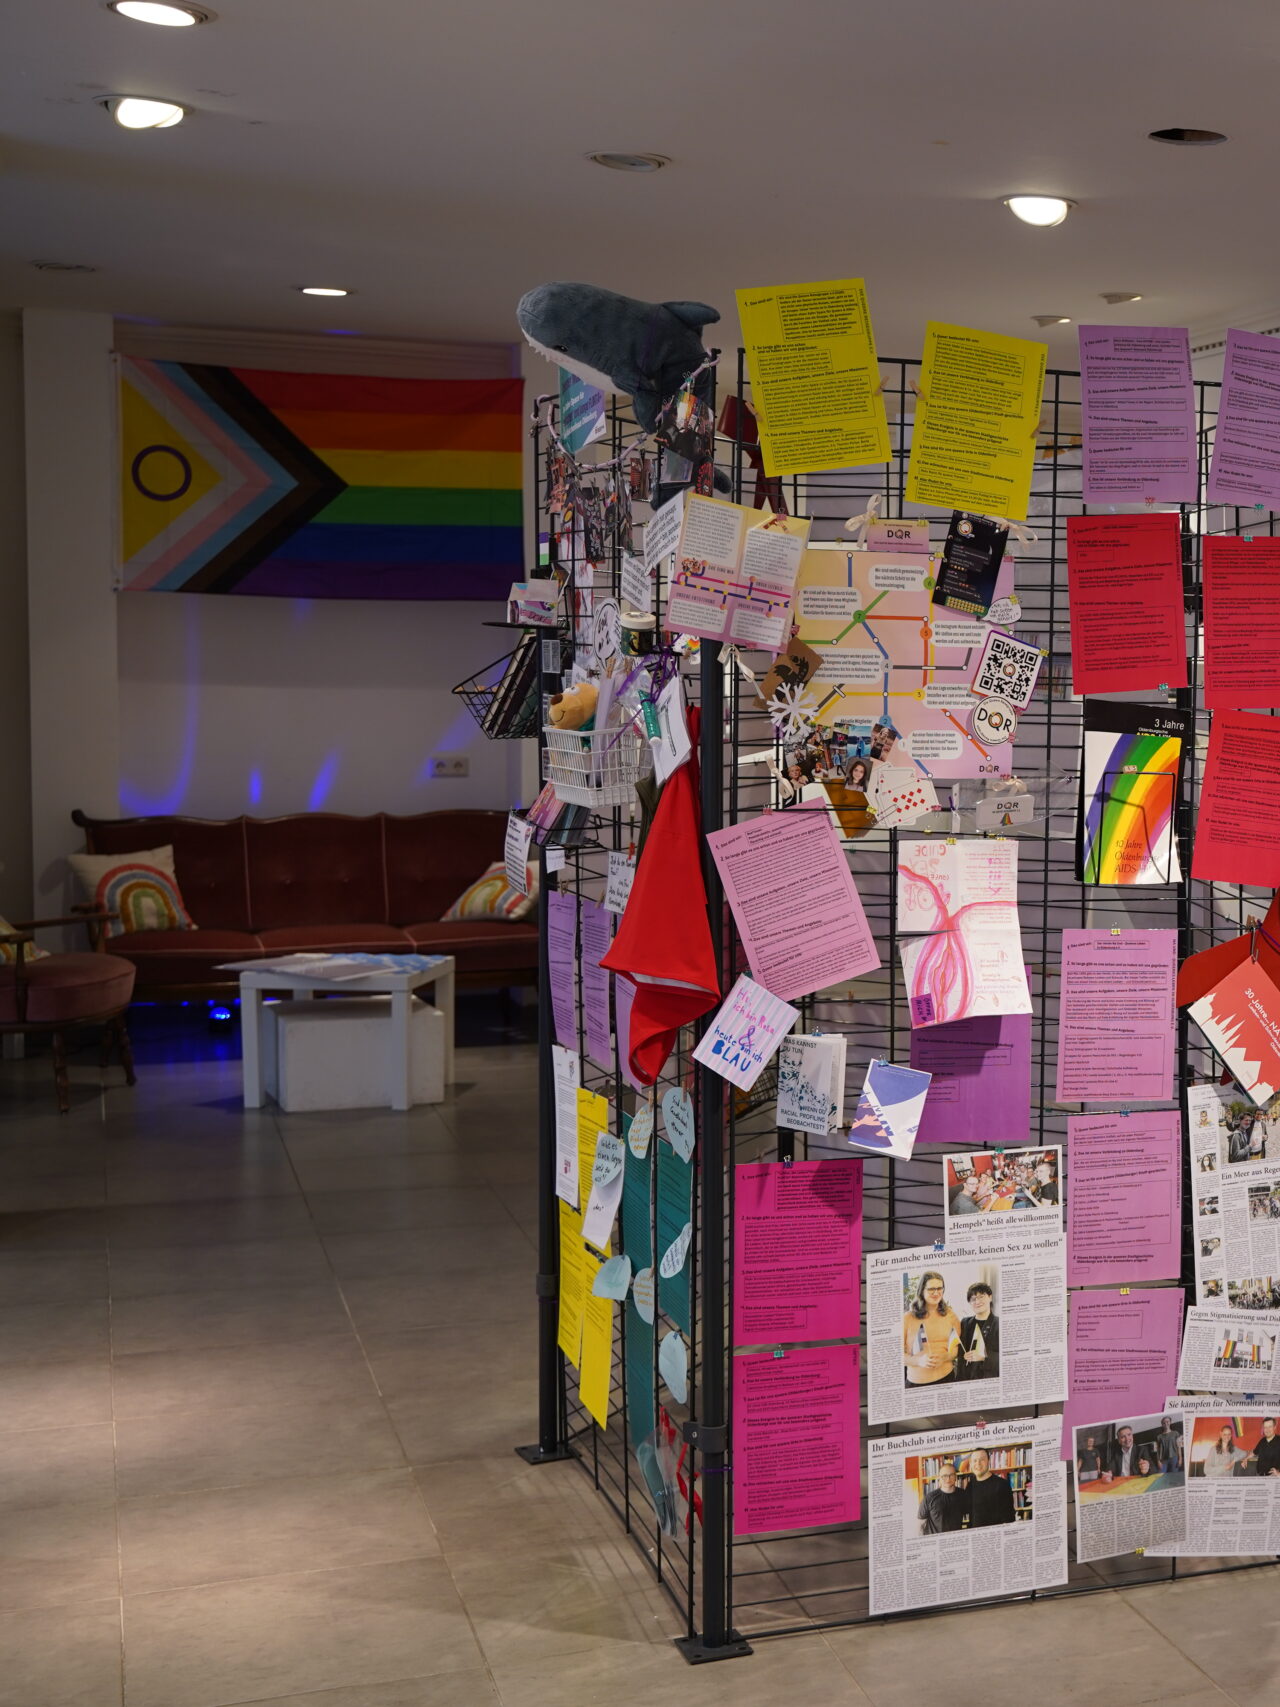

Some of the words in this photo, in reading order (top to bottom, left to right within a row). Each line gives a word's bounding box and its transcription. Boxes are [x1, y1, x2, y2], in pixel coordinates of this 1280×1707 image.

[887, 529, 911, 540] DQR
[1154, 718, 1160, 727] 3
[1162, 720, 1185, 730] Jahre
[1124, 840, 1143, 849] Jahre
[1114, 864, 1137, 873] AIDS
[1245, 988, 1255, 999] 30
[1269, 1021, 1280, 1036] NA
[714, 1025, 737, 1046] heute
[752, 1049, 762, 1063] ich
[797, 1040, 817, 1048] KANNST
[712, 1039, 751, 1072] BLAU
[781, 1109, 798, 1117] RACIAL
[800, 1113, 825, 1122] PROFILING
[787, 1118, 825, 1130] BEOBACHTEST?
[949, 1219, 985, 1231] „Hempels“
[987, 1218, 1004, 1226] heißt
[1006, 1216, 1017, 1224] alle
[1018, 1213, 1059, 1223] willkommen
[870, 1258, 889, 1268] „Für
[891, 1254, 921, 1264] manche
[923, 1247, 977, 1260] unvorstellbar,
[979, 1246, 1005, 1254] keinen
[1008, 1244, 1020, 1252] Sex
[1034, 1238, 1063, 1248] wollen“
[1190, 1310, 1209, 1319] Gegen
[1210, 1311, 1255, 1322] Stigmatisierung
[1181, 1401, 1211, 1410] kämpfen
[872, 1442, 885, 1452] Ihr
[887, 1438, 924, 1450] Buchclub
[926, 1436, 936, 1444] ist
[938, 1429, 980, 1442] einzigartig
[992, 1426, 1006, 1434] der
[1008, 1423, 1035, 1433] Region
